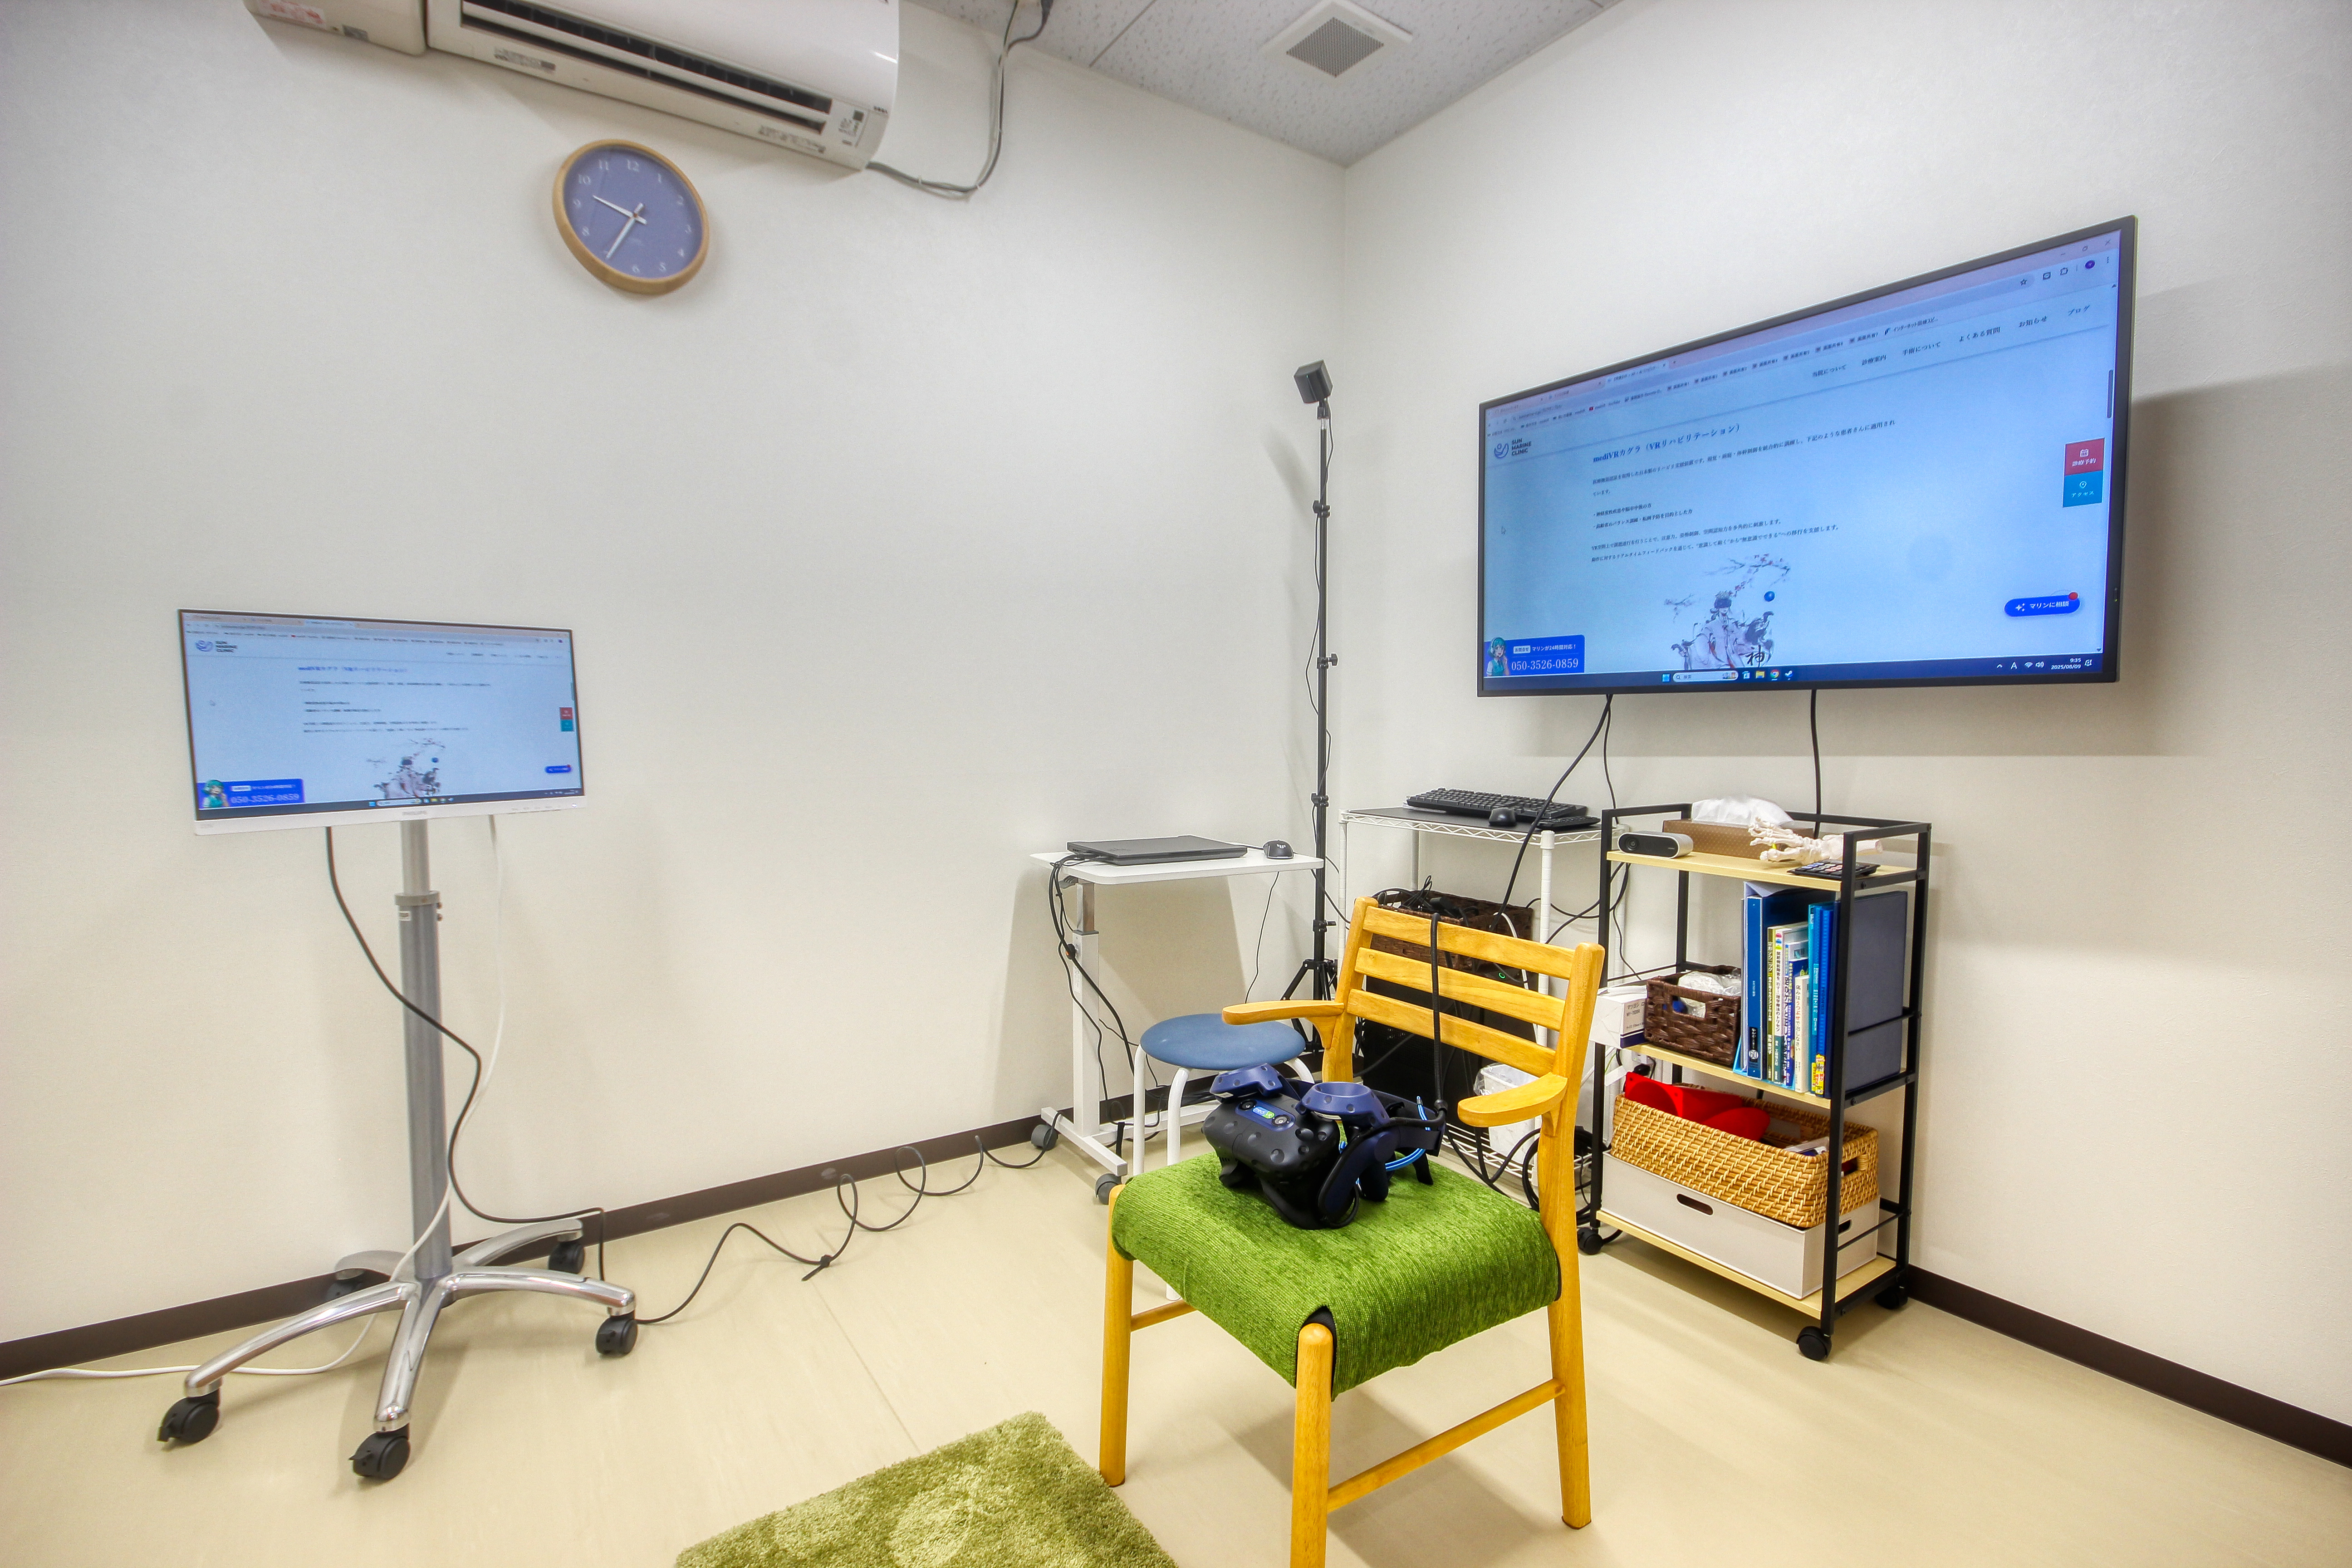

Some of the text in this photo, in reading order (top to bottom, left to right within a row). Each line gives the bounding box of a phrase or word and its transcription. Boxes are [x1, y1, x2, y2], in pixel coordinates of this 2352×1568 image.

[2018, 315, 2048, 328] お知らせ
[1958, 326, 2001, 343] よくある質問
[1902, 341, 1941, 356] 手術について
[1511, 441, 1532, 451] MARINE
[1511, 448, 1529, 456] CLINIC
[2029, 600, 2070, 609] マリンに相談
[1511, 658, 1578, 671] 050-3526-0859
